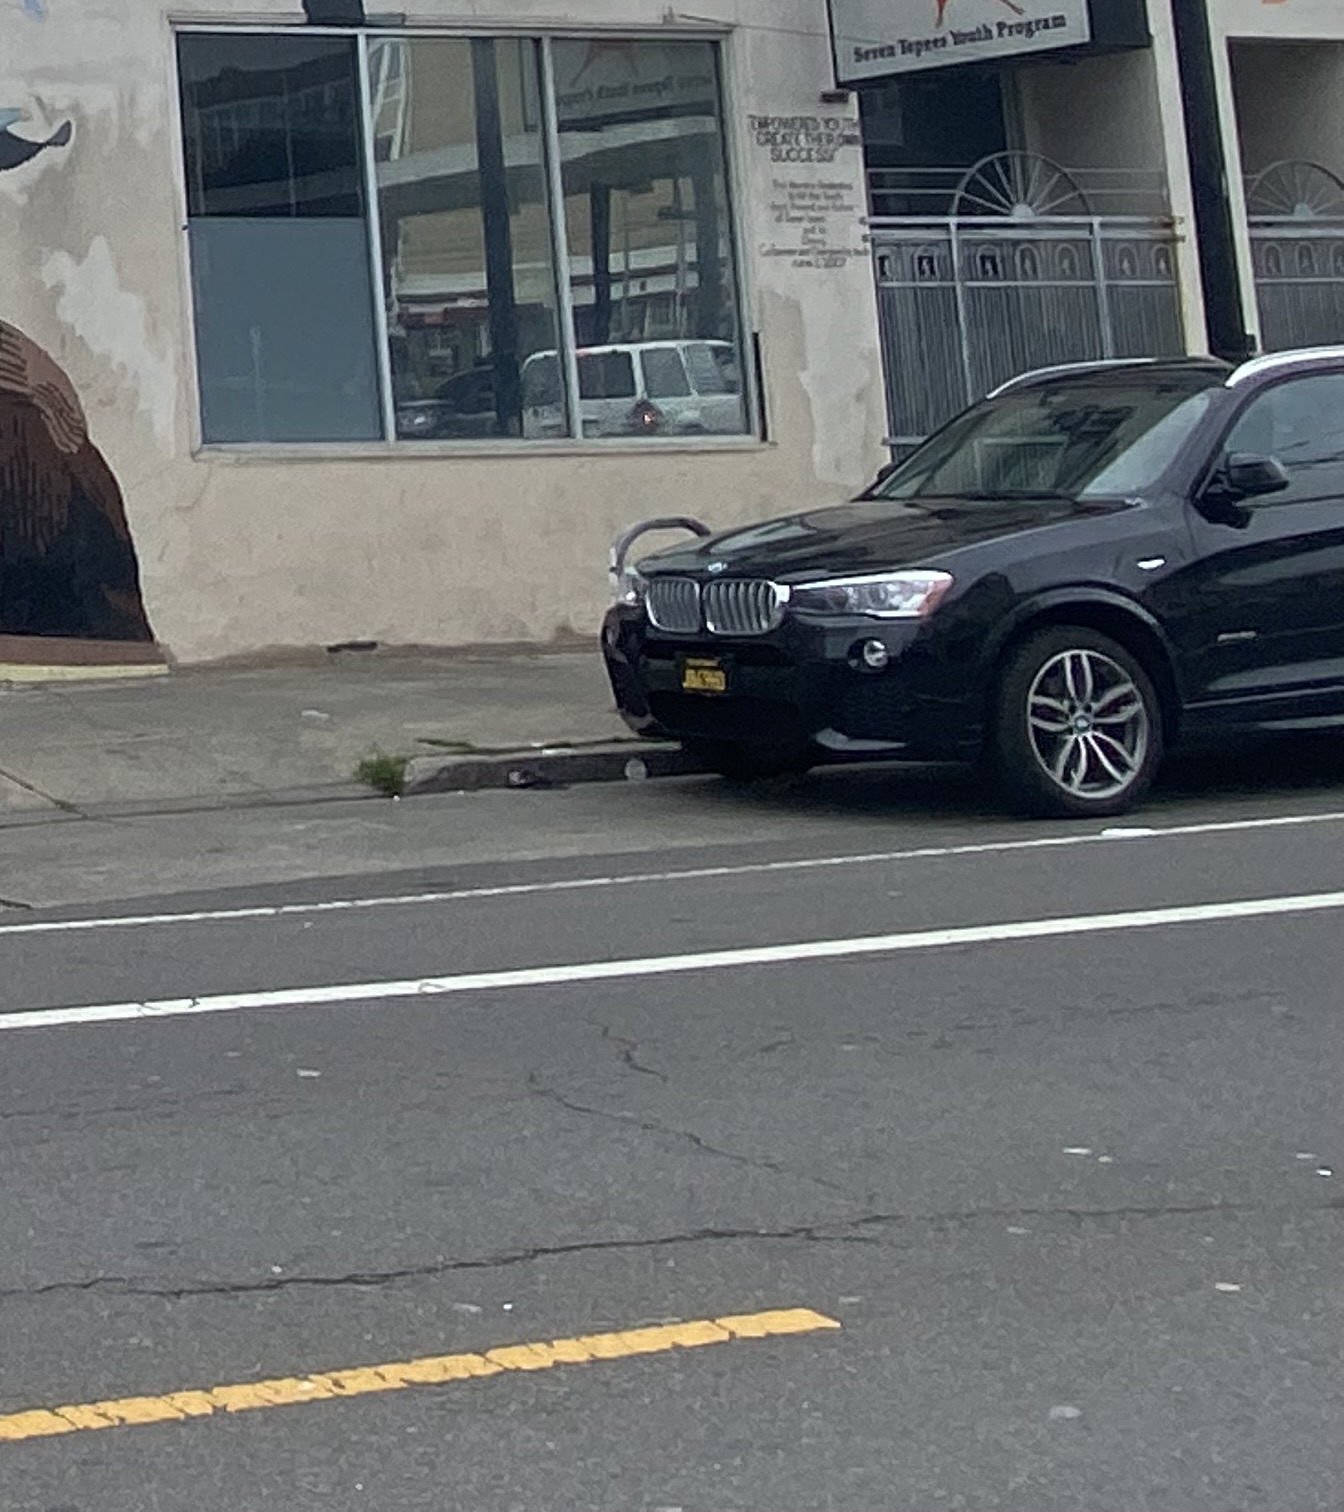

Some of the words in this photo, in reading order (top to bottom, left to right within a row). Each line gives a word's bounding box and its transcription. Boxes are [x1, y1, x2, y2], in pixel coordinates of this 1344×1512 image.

[853, 44, 896, 63] Seven
[898, 35, 947, 57] Tepees
[949, 23, 993, 46] Youth
[996, 14, 1067, 39] Program
